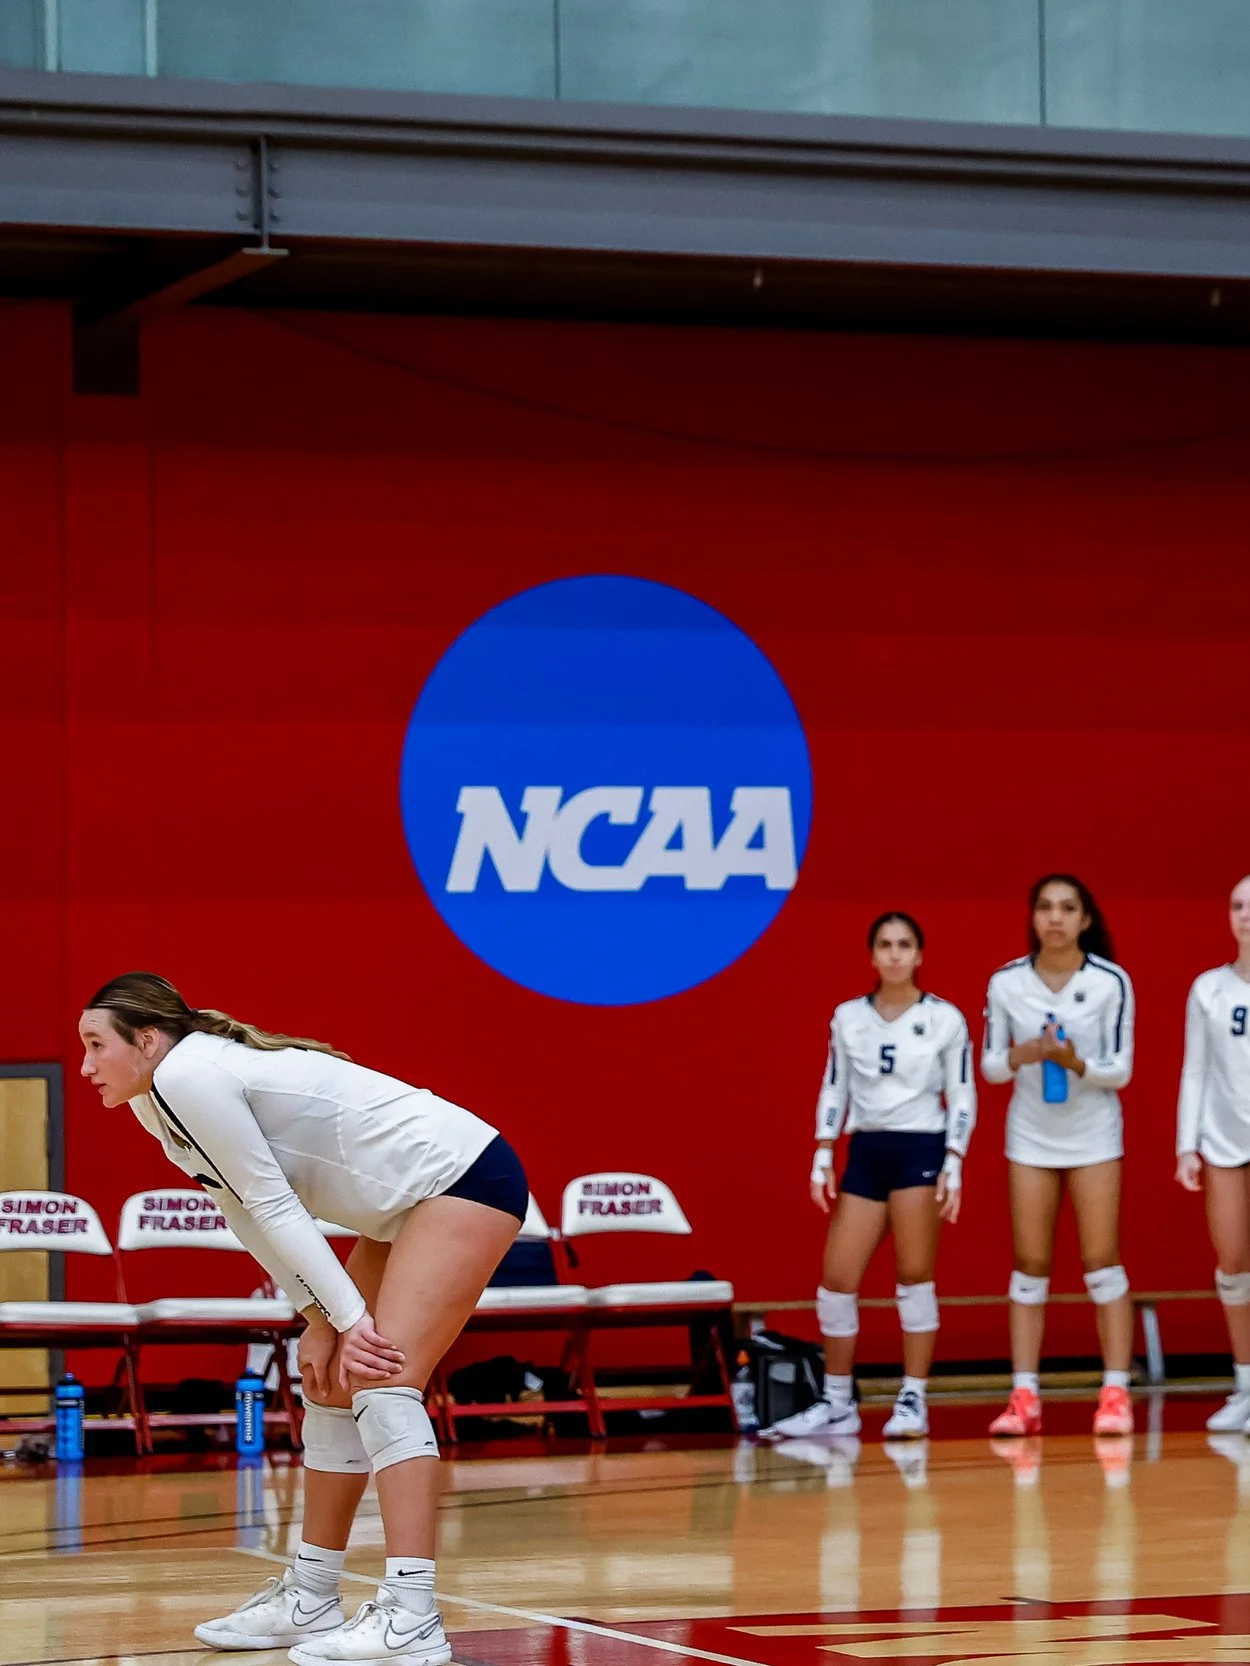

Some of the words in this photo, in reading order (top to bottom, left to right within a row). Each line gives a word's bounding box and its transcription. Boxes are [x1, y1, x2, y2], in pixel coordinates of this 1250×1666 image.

[446, 786, 798, 892] NCAA
[1230, 1006, 1249, 1037] 9
[880, 1044, 896, 1075] 5
[582, 1182, 651, 1196] SIMON
[1, 1201, 78, 1214] SIMON
[142, 1199, 216, 1211] SIMON
[577, 1199, 662, 1215] FRASER
[138, 1216, 228, 1231] FRASER
